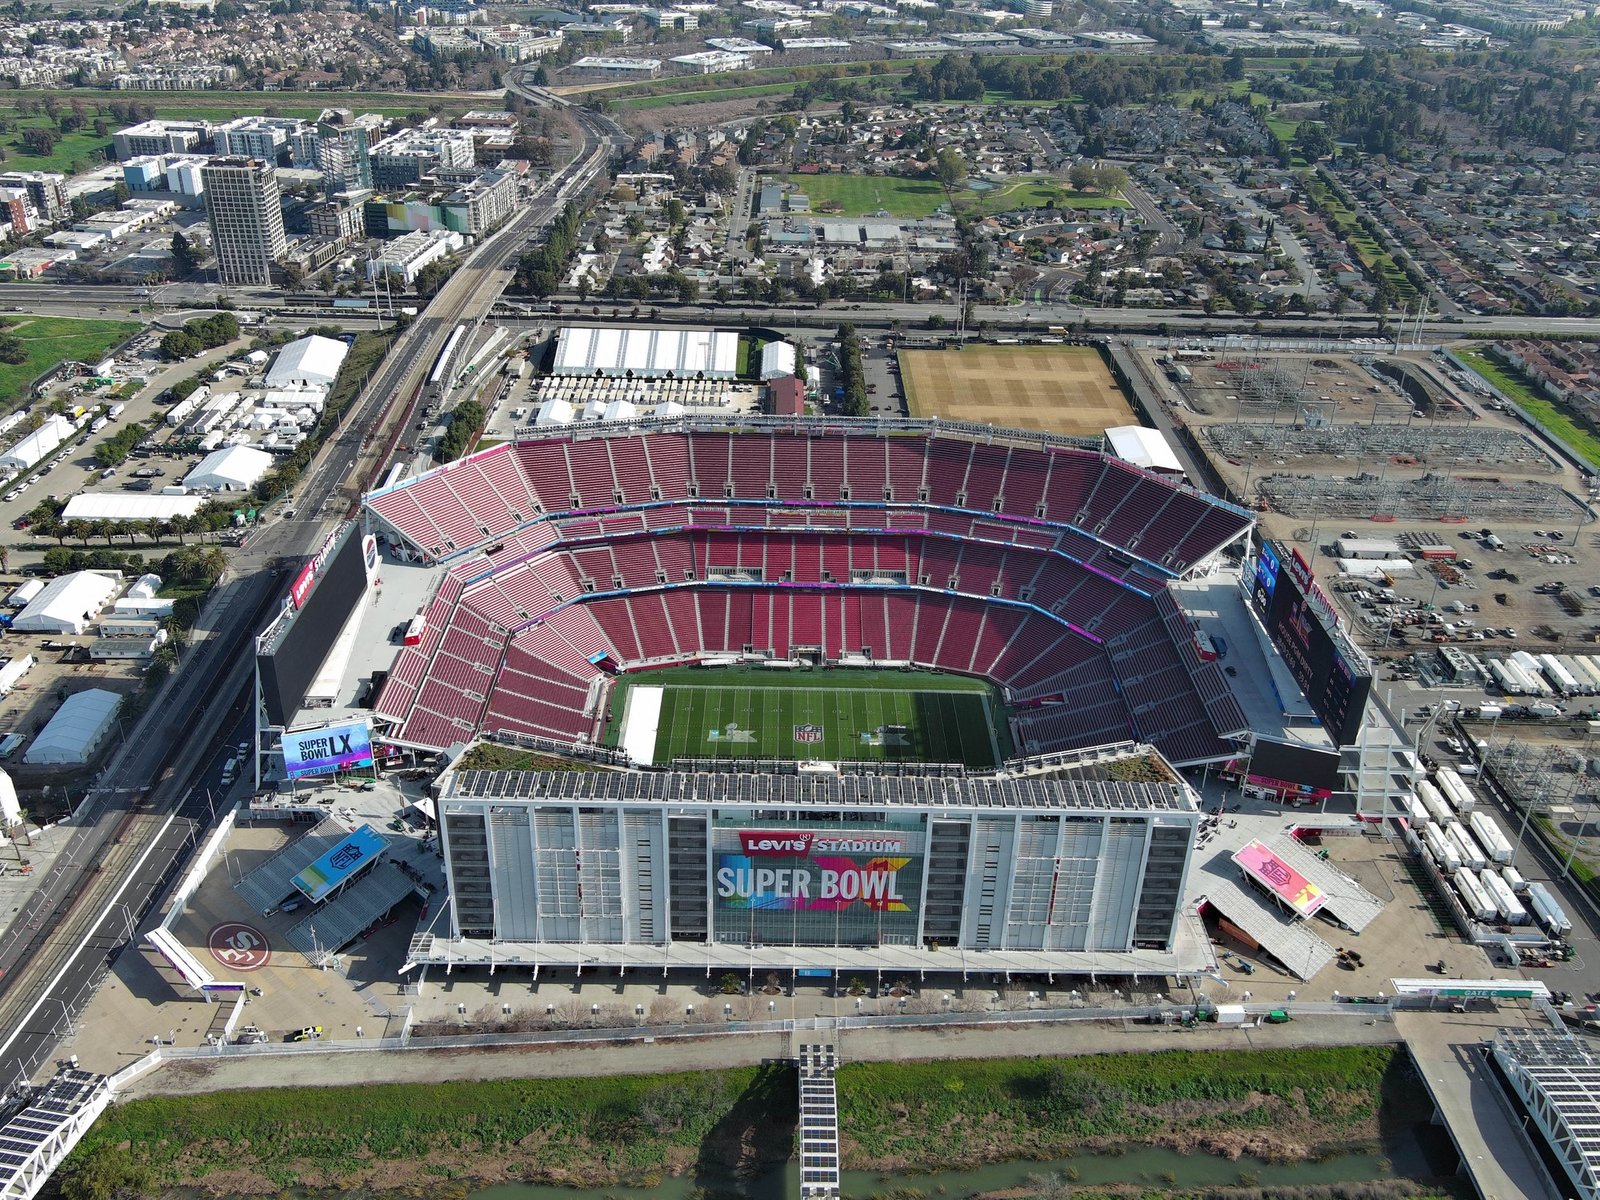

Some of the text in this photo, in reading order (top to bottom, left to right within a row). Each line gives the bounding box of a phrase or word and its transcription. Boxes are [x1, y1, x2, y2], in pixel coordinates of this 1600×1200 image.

[796, 732, 820, 742] NFL
[298, 734, 353, 756] SUPER LX
[300, 748, 330, 761] BOWL
[300, 768, 320, 777] SUPER
[320, 764, 336, 774] BOWL
[817, 840, 900, 852] STADIUM
[332, 850, 350, 866] NFL
[717, 867, 903, 900] SUPER BOWL
